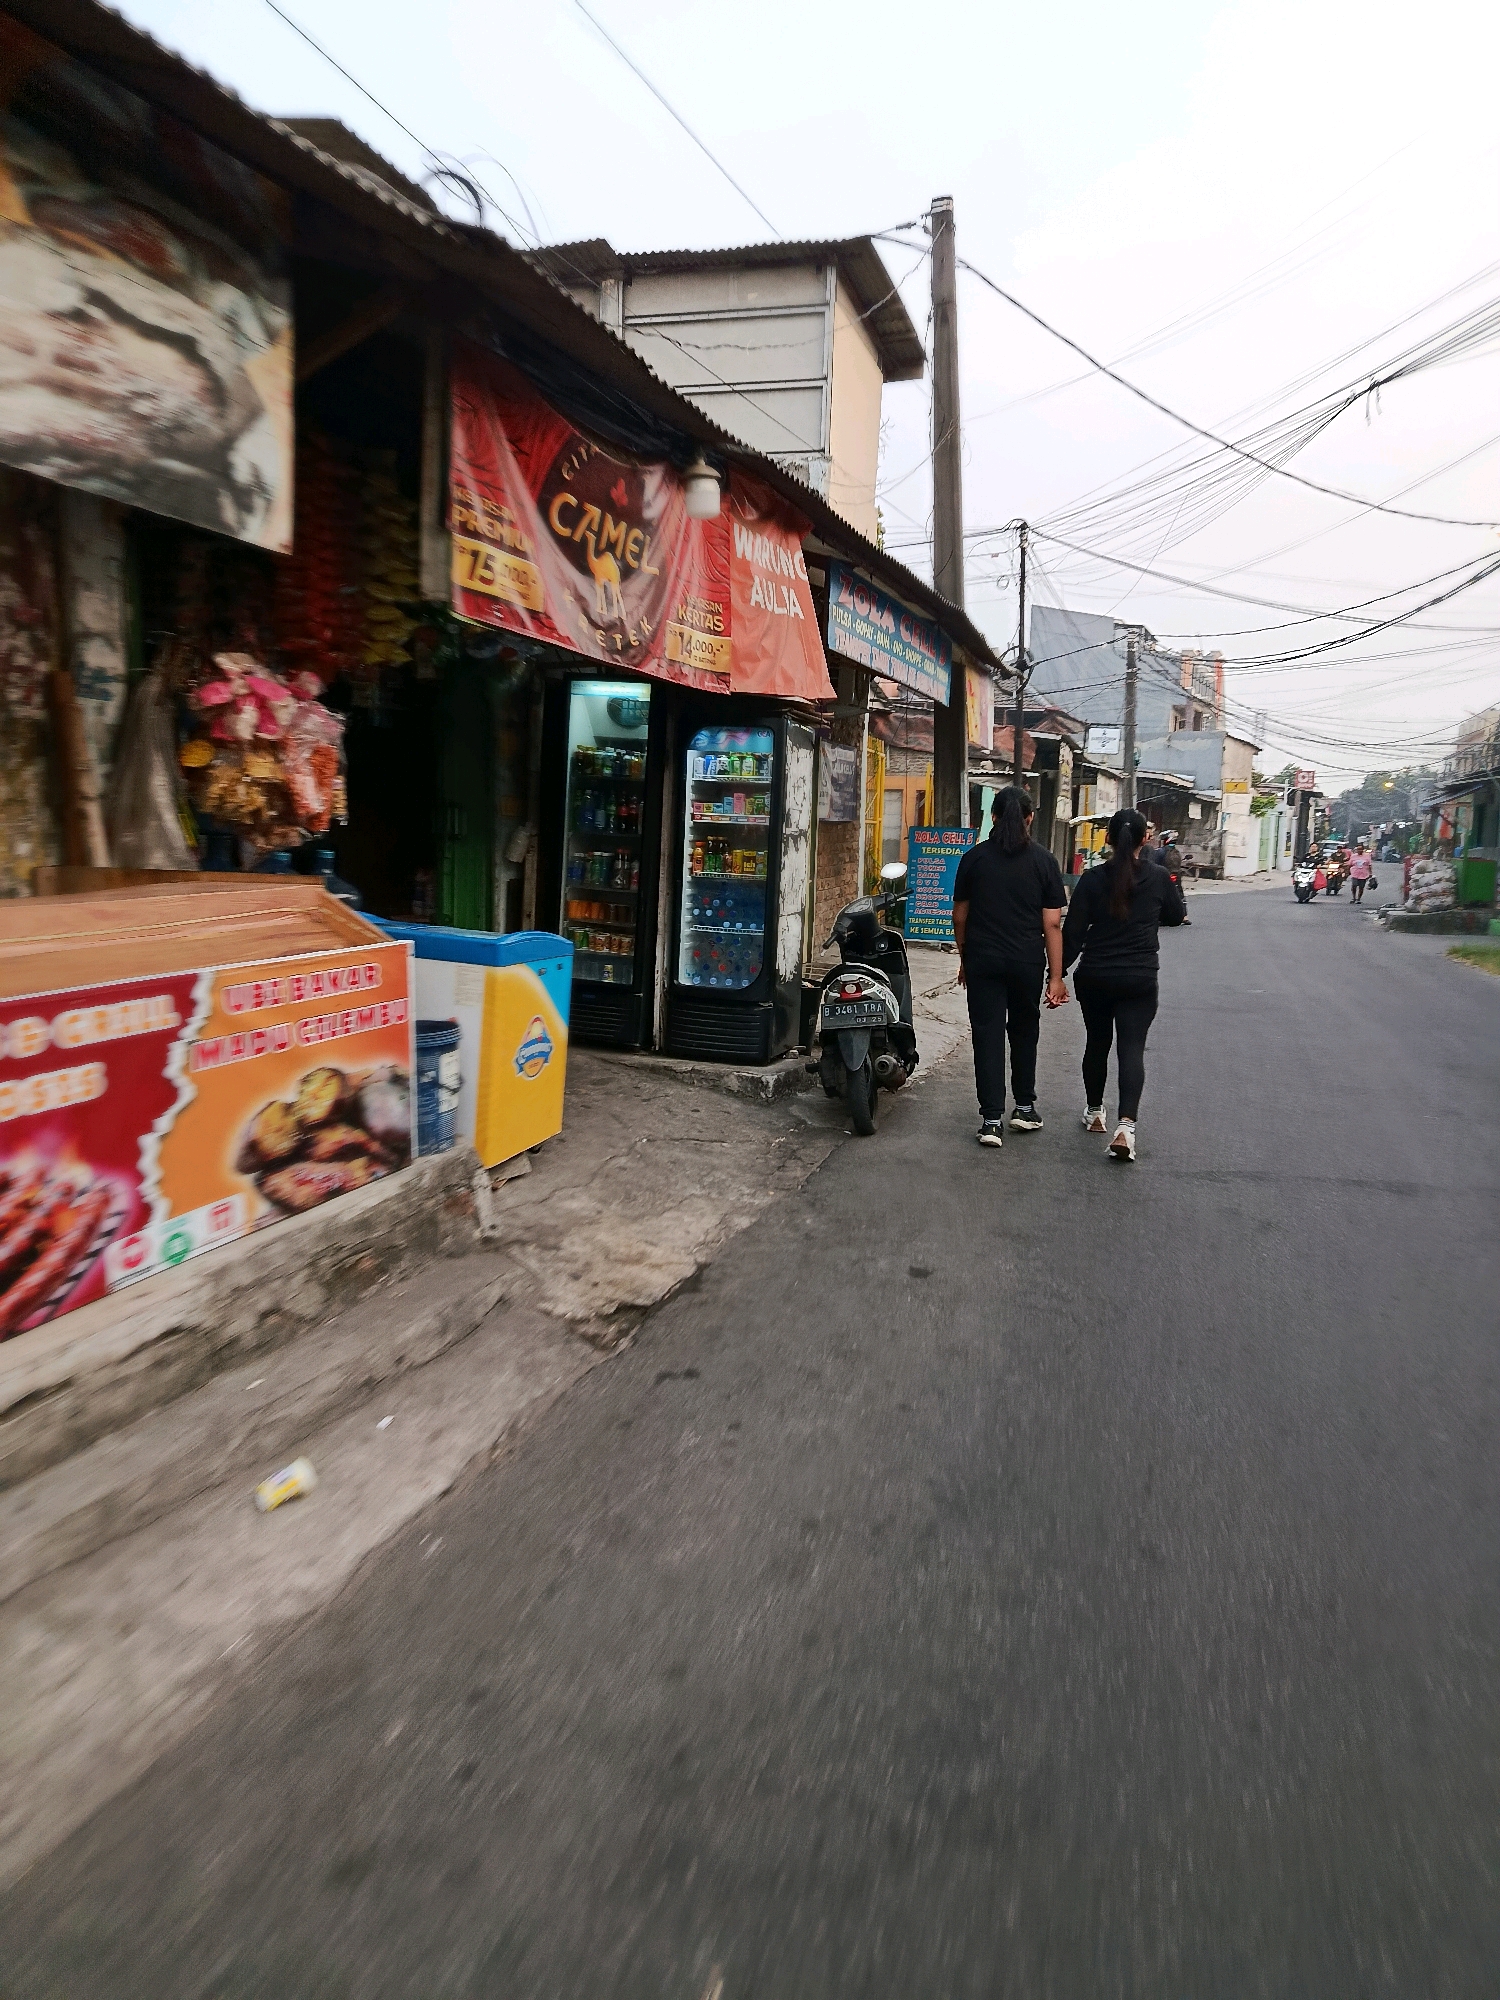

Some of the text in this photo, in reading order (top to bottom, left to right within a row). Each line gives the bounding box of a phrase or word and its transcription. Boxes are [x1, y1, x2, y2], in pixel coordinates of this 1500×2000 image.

[550, 492, 660, 576] CAMEL
[750, 574, 805, 620] AULIA
[677, 603, 725, 632] KERTAS
[832, 604, 852, 629] PULSA
[838, 571, 896, 635] ZOLA
[900, 614, 936, 659] CELL
[914, 831, 940, 844] ZOLA
[942, 831, 966, 845] CELL
[909, 917, 936, 925] TRANSFER
[824, 1007, 830, 1016] B
